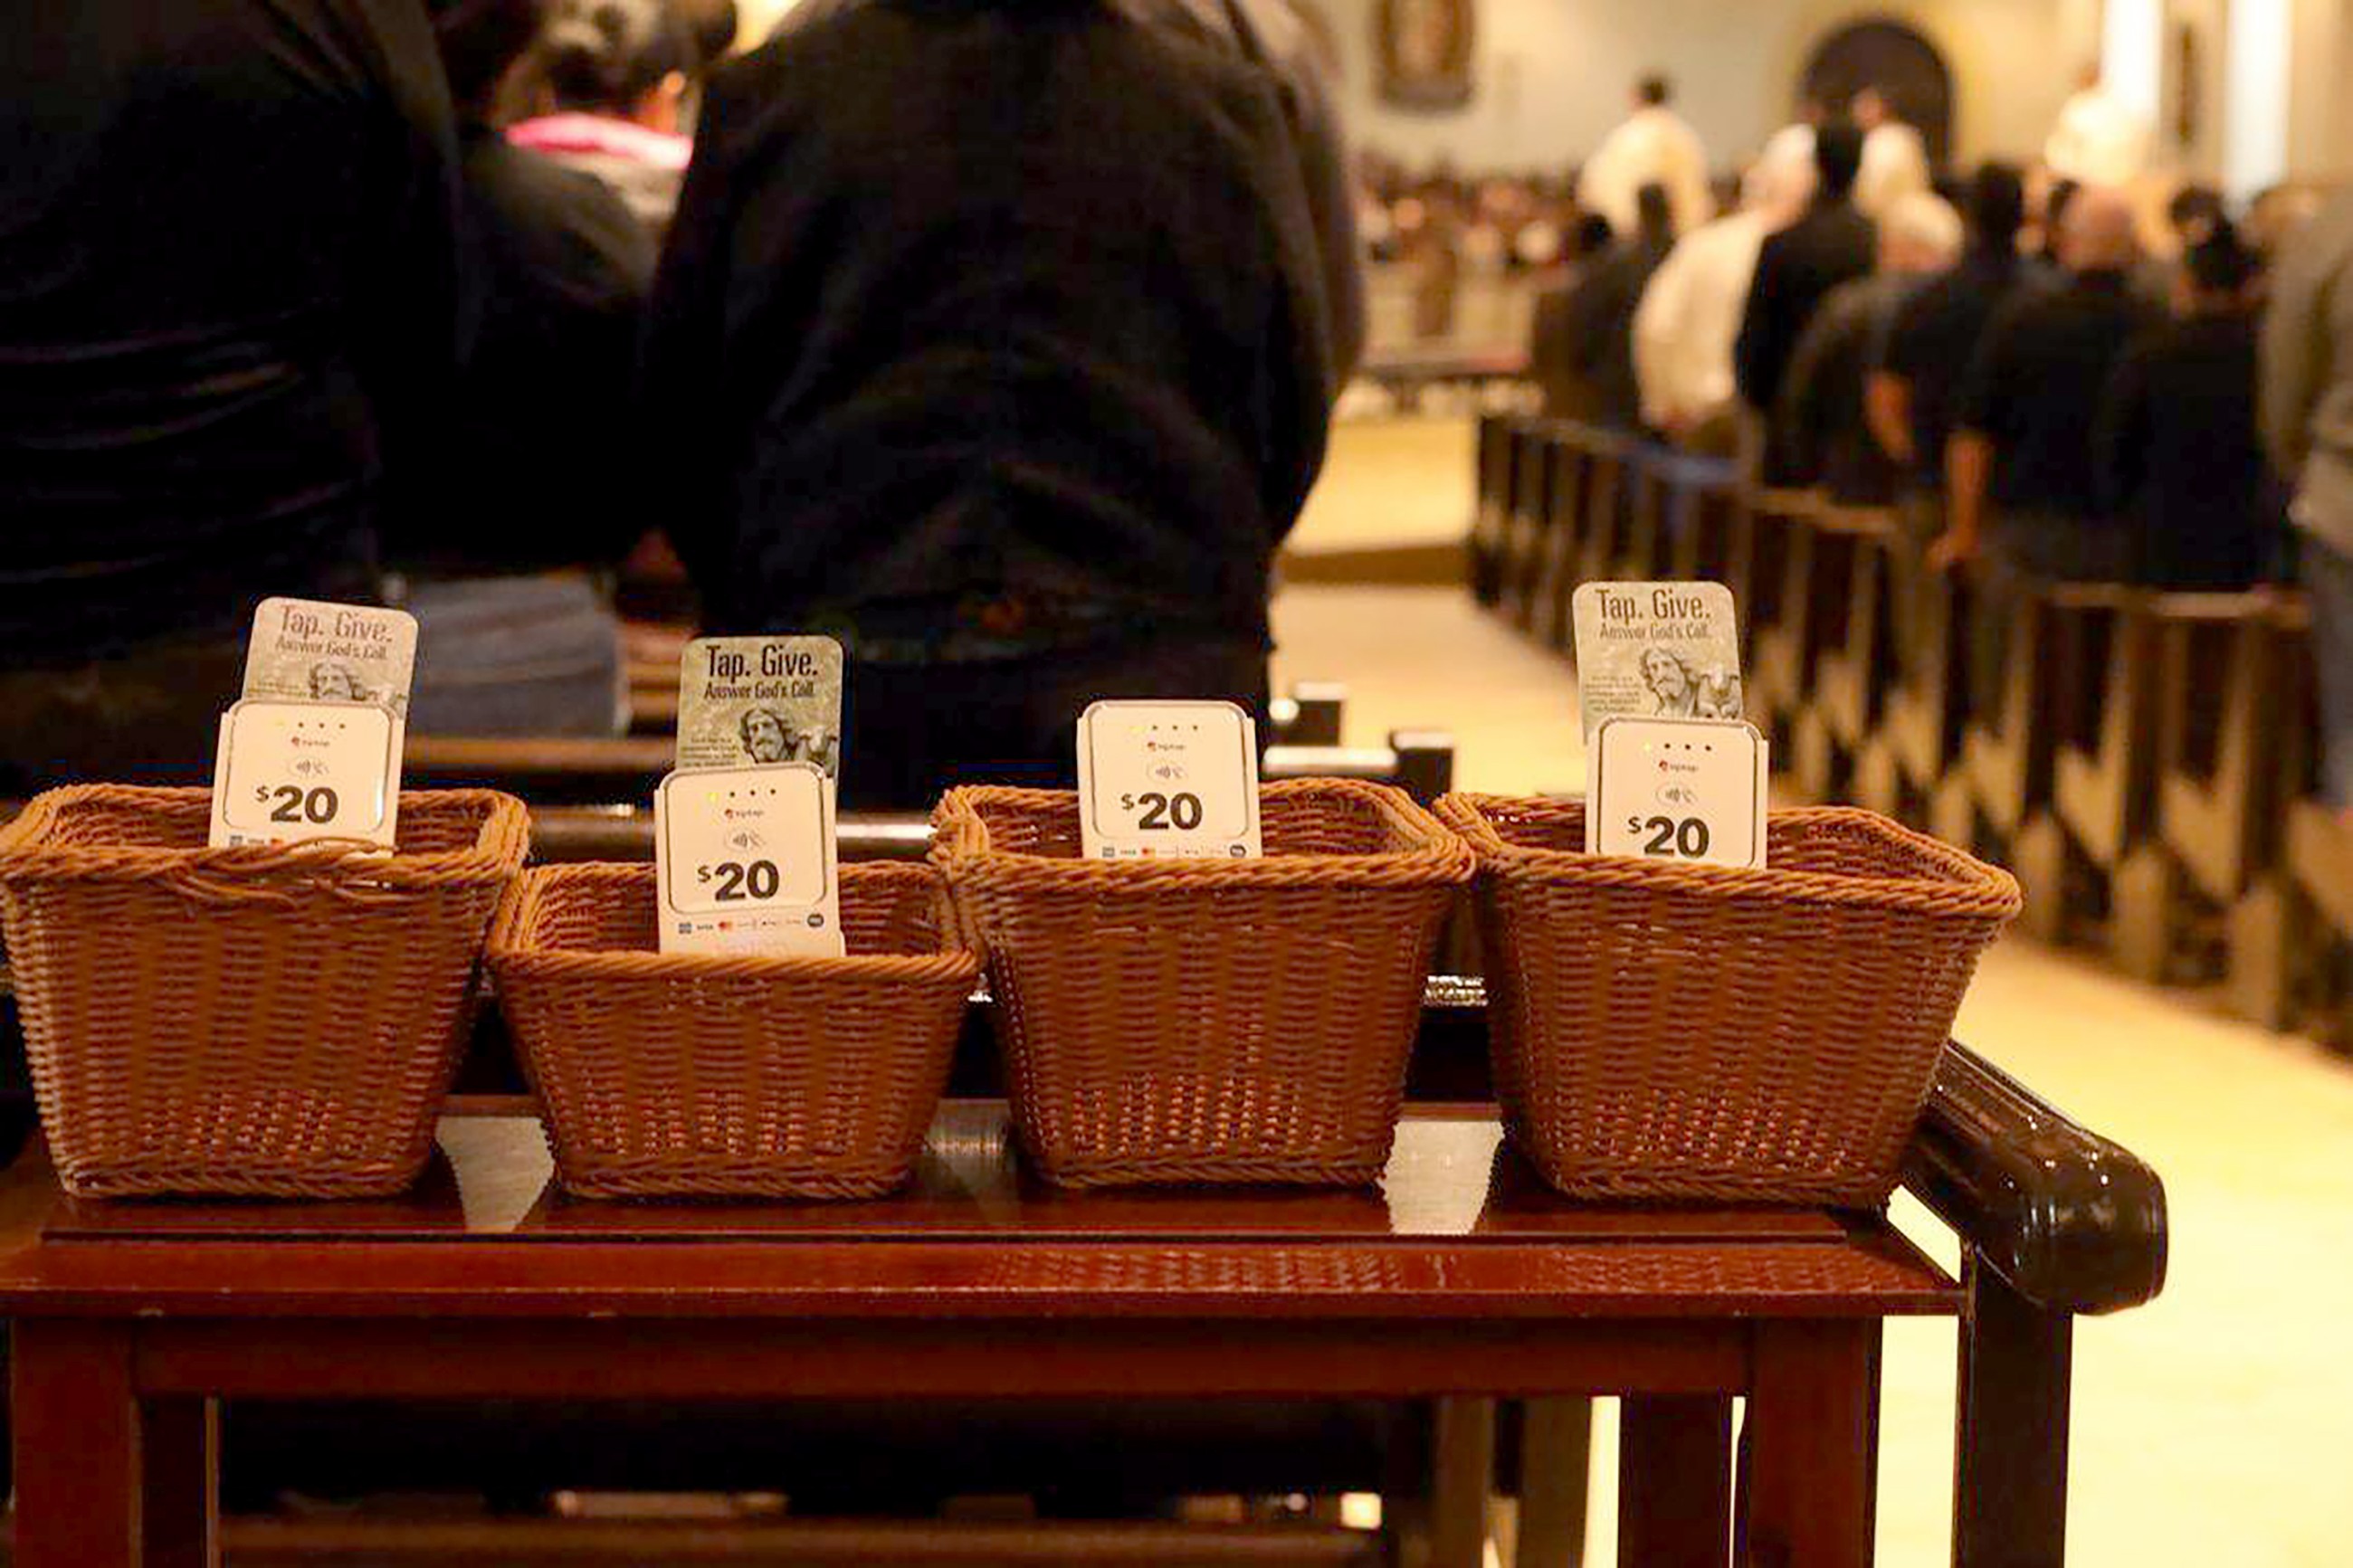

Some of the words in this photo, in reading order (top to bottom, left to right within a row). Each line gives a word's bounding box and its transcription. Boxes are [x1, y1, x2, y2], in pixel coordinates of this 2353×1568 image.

[281, 604, 324, 640] Tap.
[335, 610, 393, 643] Give.
[1595, 589, 1643, 625] Tap.
[1653, 588, 1710, 619] Give.
[705, 644, 751, 683] Tap.
[761, 644, 819, 677] Give.
[704, 681, 751, 700] Answer
[254, 784, 339, 824] $20
[1120, 792, 1204, 831] $20
[1627, 815, 1710, 859] $20
[697, 860, 780, 901] $20
